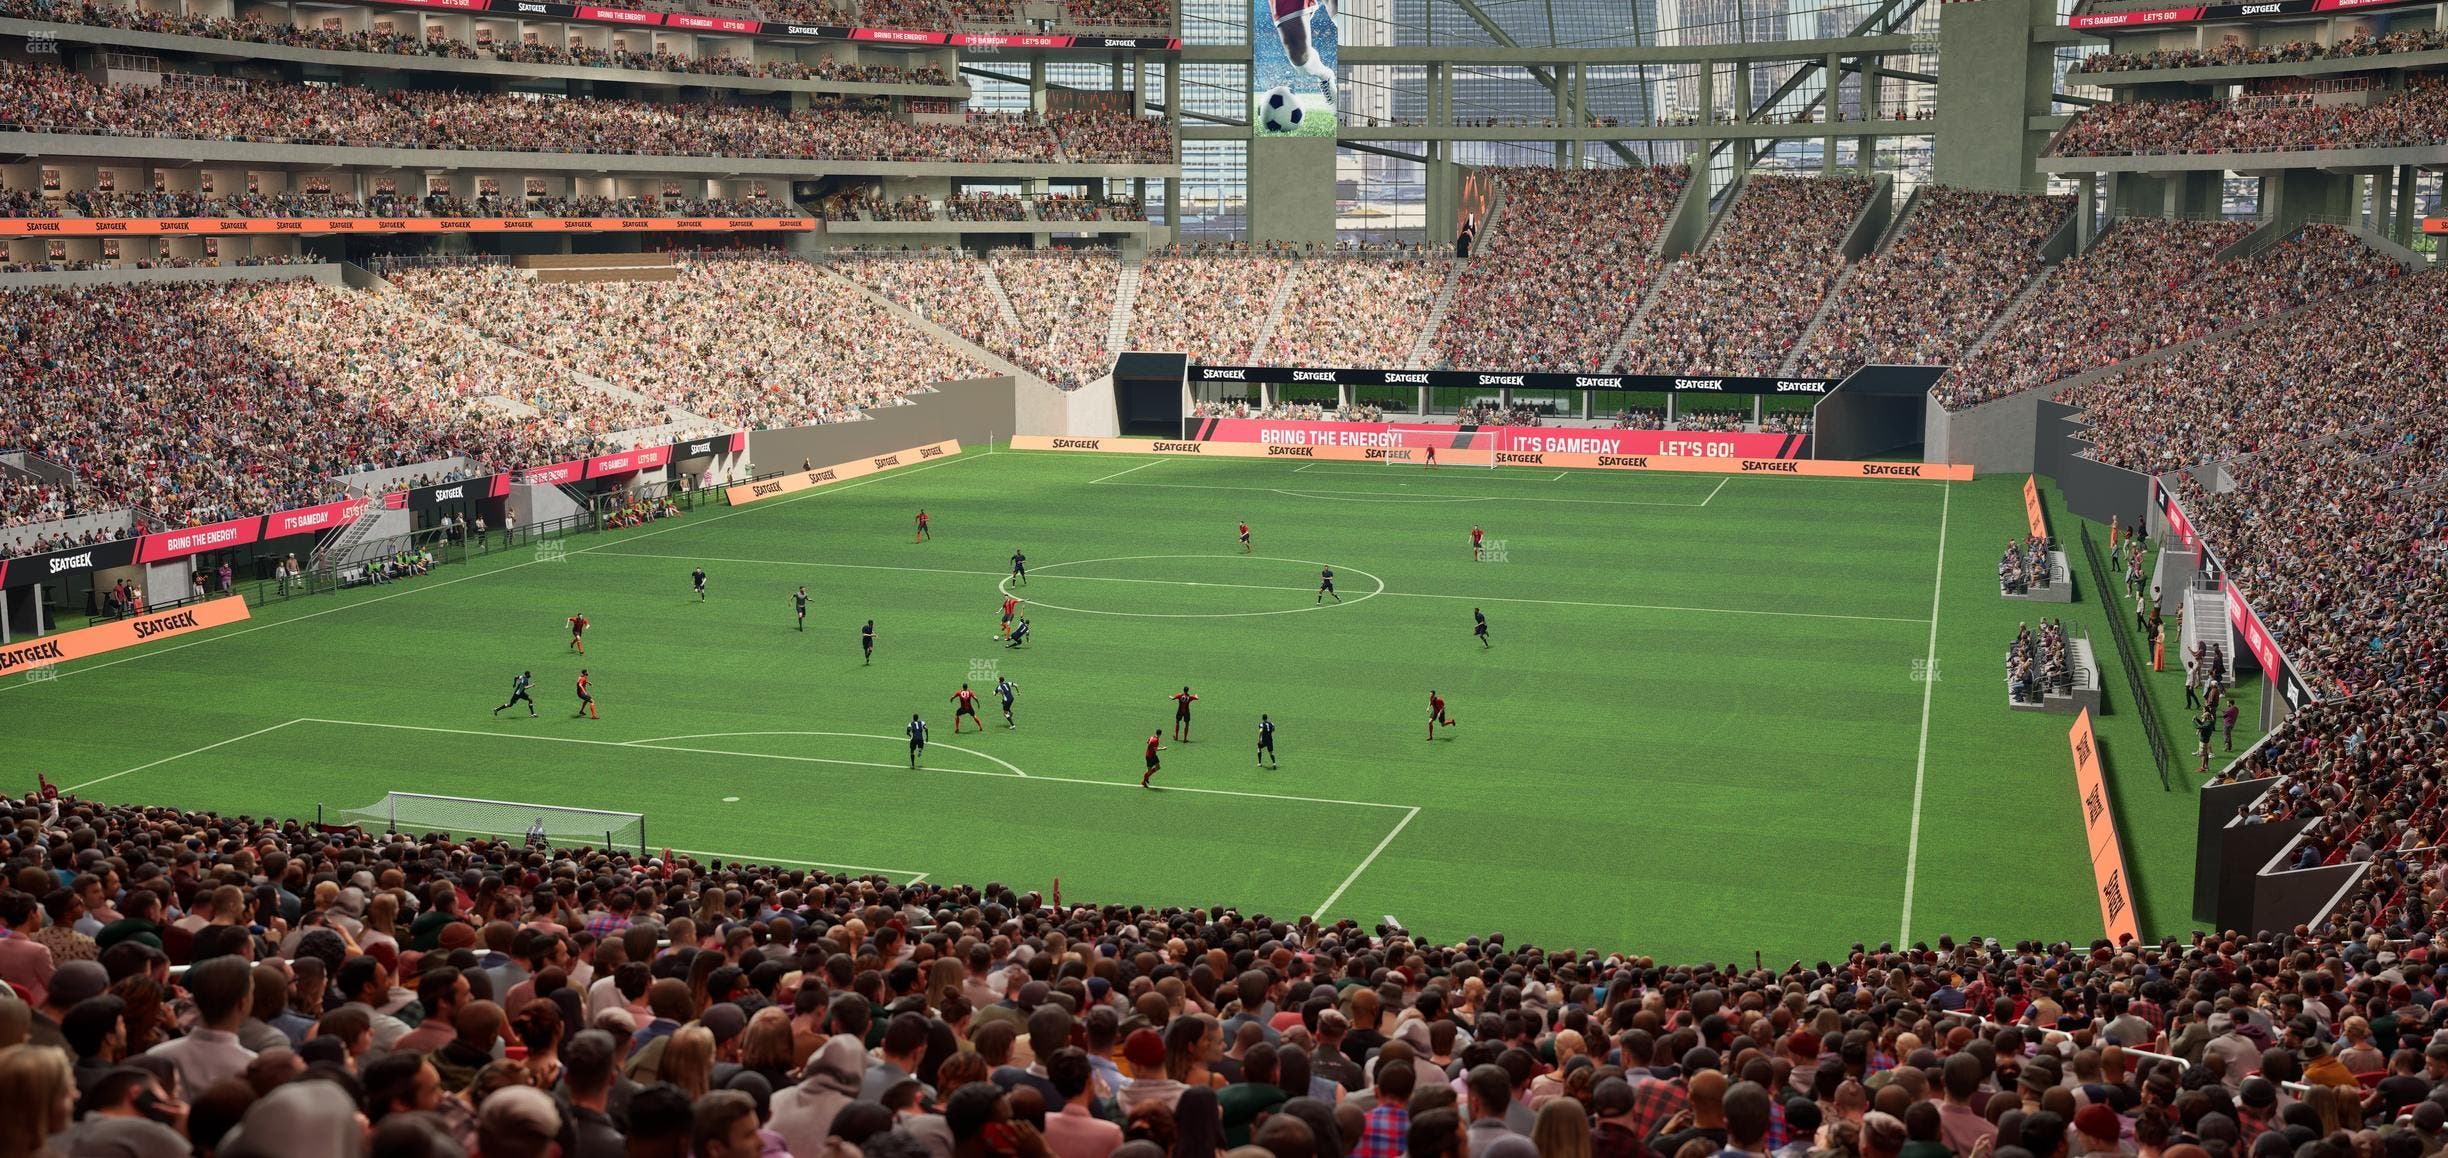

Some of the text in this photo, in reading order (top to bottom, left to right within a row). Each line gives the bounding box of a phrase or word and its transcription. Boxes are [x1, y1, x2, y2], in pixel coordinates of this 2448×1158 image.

[518, 3, 547, 13] SEATGEEK
[2242, 3, 2280, 15] SEATGEEK
[2080, 15, 2127, 26] IT'S GAMEDAY
[2143, 12, 2177, 21] LET'S GO!
[788, 26, 818, 36] SEATGEEK
[1105, 39, 1136, 48] SEATGEEK
[26, 222, 60, 232] SEATGEEK
[95, 222, 127, 231] SEATGEEK
[160, 222, 189, 231] SEATGEEK
[220, 222, 248, 230] SEATGEEK
[277, 221, 302, 229] SEATGEEK
[329, 221, 353, 229] SEATGEEK
[379, 221, 405, 229] SEATGEEK
[440, 221, 471, 229] SEATGEEK
[564, 220, 592, 228] SEATGEEK
[1203, 369, 1246, 380] SEATGEEK
[1293, 371, 1336, 382] SEATGEEK
[1385, 372, 1429, 384] SEATGEEK
[1479, 375, 1525, 386] SEATGEEK
[1576, 377, 1622, 389] SEATGEEK
[1675, 378, 1723, 391] SEATGEEK
[1776, 380, 1826, 393] SEATGEEK
[1052, 438, 1099, 450] SEATGEEK
[1261, 429, 1403, 447] BRING THE ENERGY!
[1153, 441, 1201, 454] SEATGEEK
[1513, 436, 1621, 454] IT'S GAMEDAY
[1659, 441, 1735, 458] LET'S GO!
[920, 445, 944, 459] SEATGEEK
[1268, 446, 1313, 457] SEATGEEK
[1365, 448, 1411, 460] SEATGEEK
[874, 455, 900, 470] SEATGEEK
[1496, 453, 1543, 465] SEATGEEK
[1598, 456, 1647, 468] SEATGEEK
[1742, 460, 1798, 473] SEATGEEK
[1863, 464, 1920, 477] SEATGEEK
[808, 469, 837, 484] SEATGEEK
[435, 486, 464, 503] SEATGEEK
[752, 480, 783, 497] SEATGEEK
[285, 511, 329, 529] IT'S GAMEDAY
[167, 528, 237, 551] BRING THE ENERGY!
[49, 551, 93, 574] SEATGEEK
[133, 610, 198, 639] SEATGEEK
